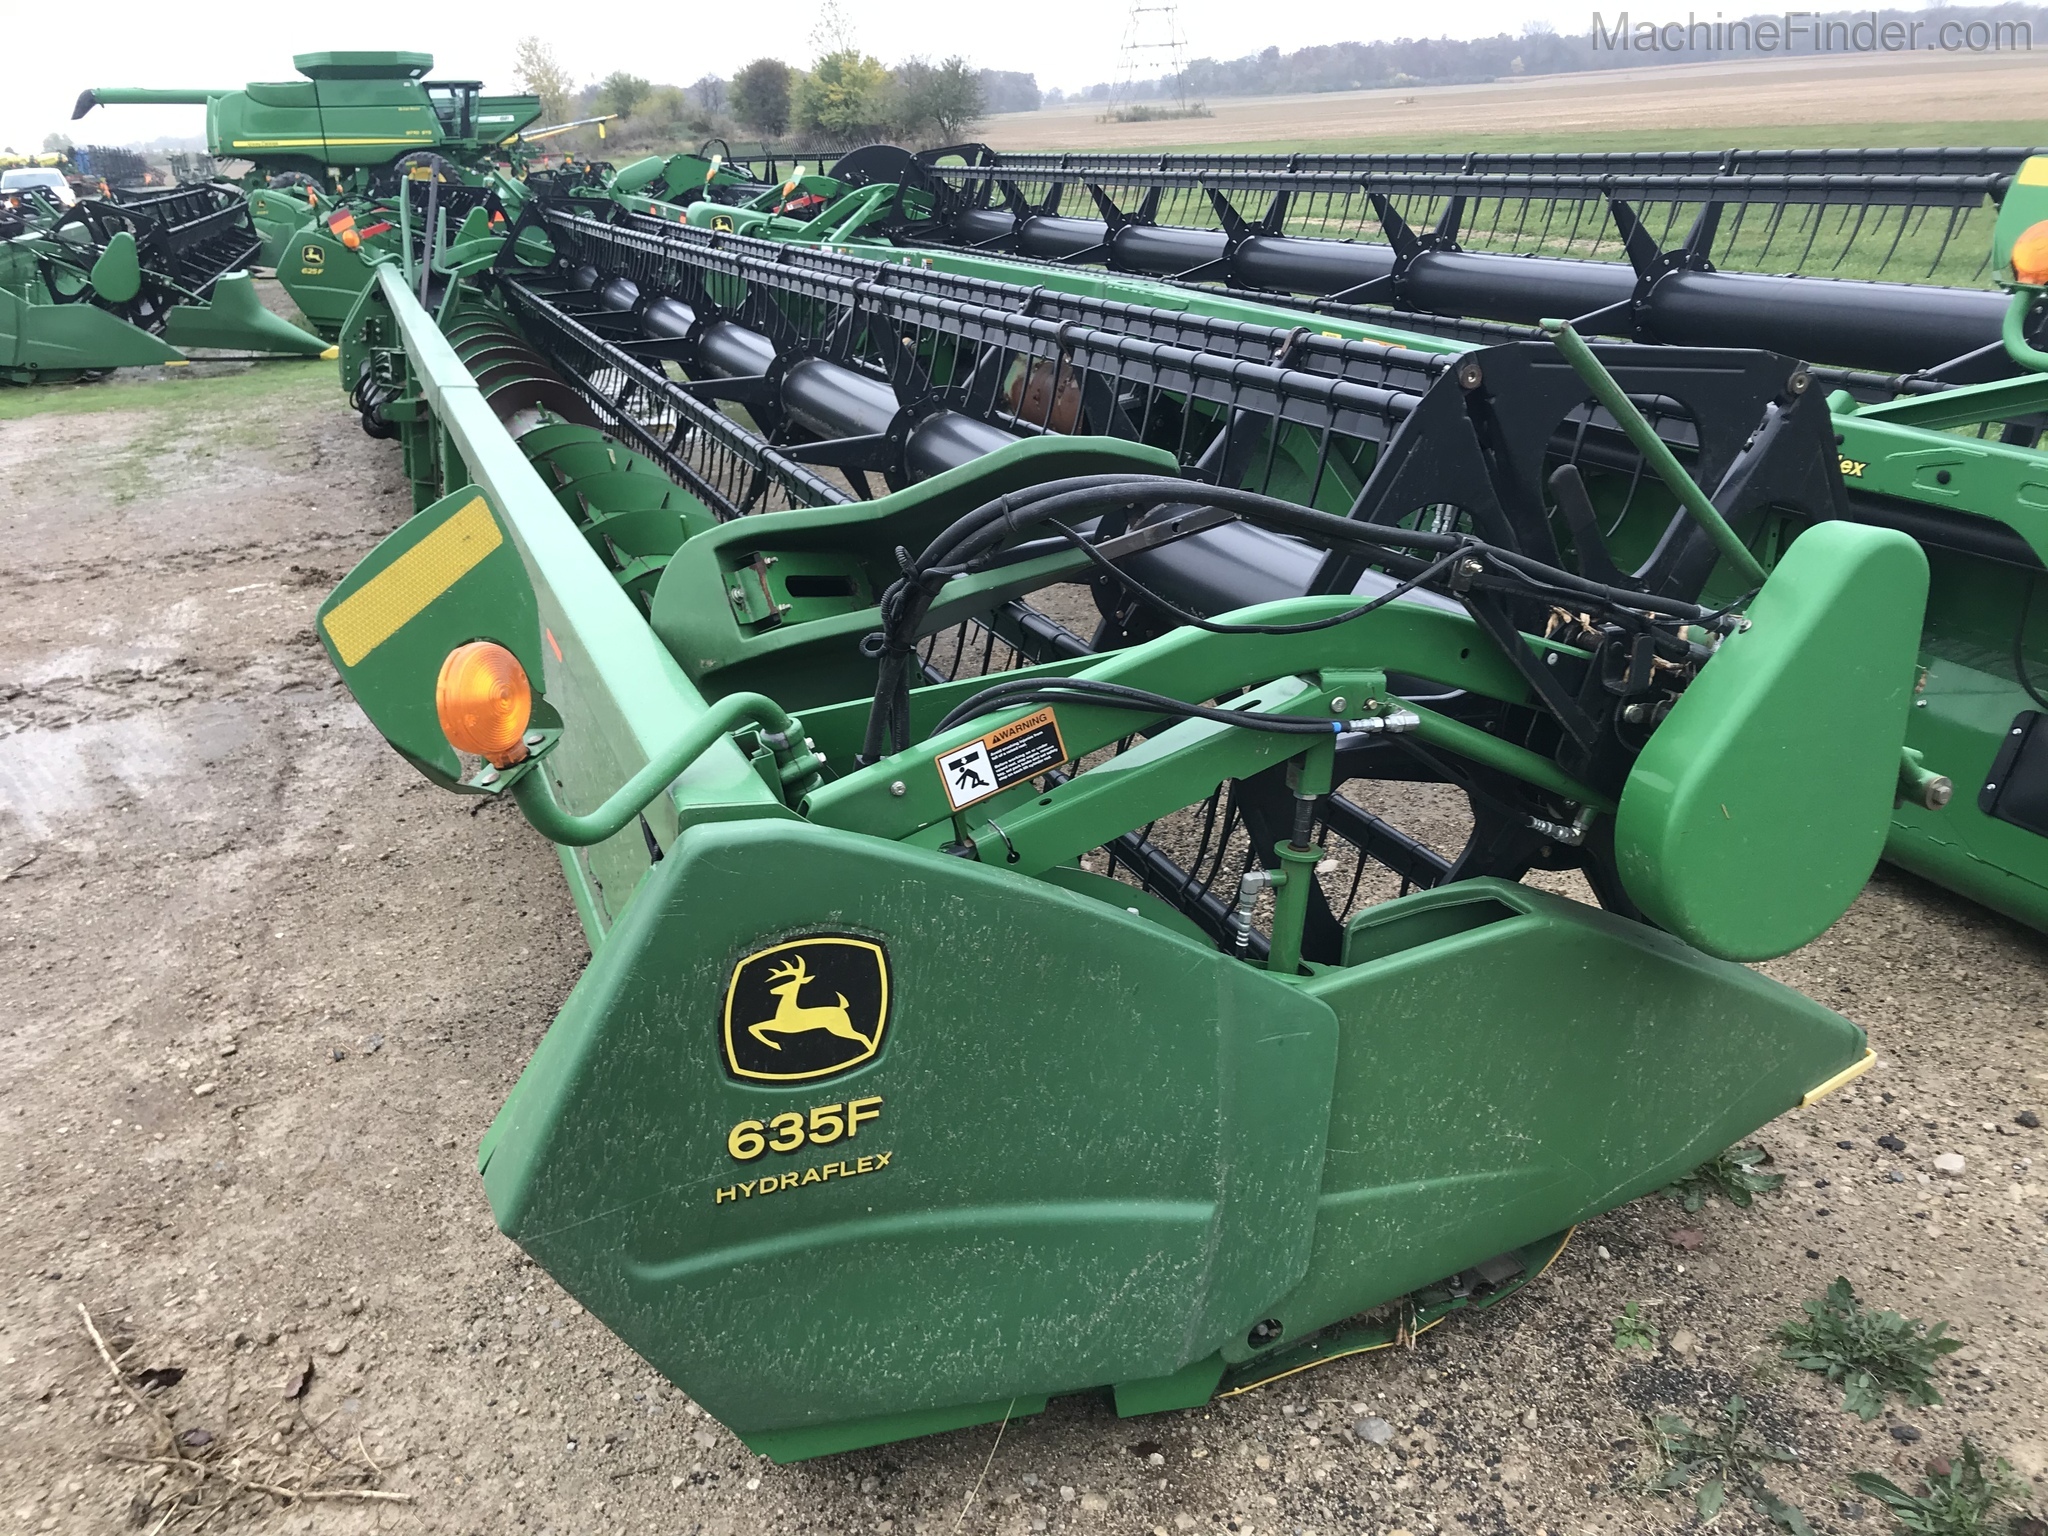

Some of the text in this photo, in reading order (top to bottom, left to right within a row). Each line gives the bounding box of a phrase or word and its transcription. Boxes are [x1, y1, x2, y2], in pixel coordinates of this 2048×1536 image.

[999, 713, 1048, 740] WARNING
[727, 1095, 884, 1162] 635F
[715, 1150, 893, 1205] HYDRAFLEX
